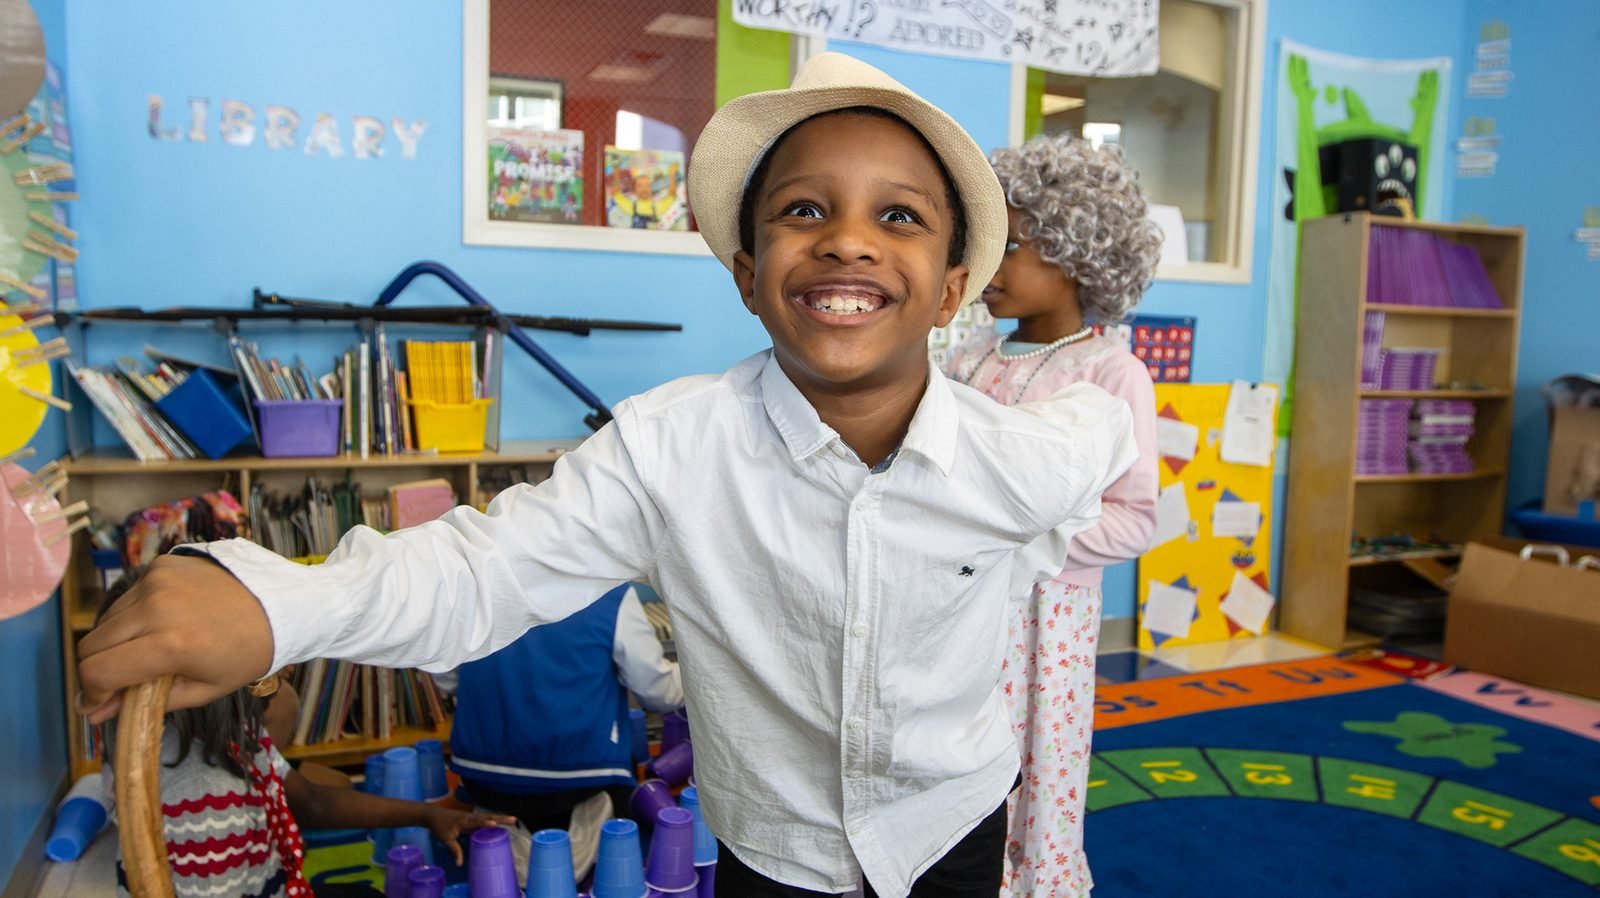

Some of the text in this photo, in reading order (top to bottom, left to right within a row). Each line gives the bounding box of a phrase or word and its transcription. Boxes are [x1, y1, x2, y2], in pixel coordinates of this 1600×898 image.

[887, 19, 985, 51] ADORED
[147, 94, 429, 160] LIBRARY
[494, 160, 576, 184] PROMISE
[1140, 760, 1198, 784] 12
[1241, 763, 1293, 786] 13
[1346, 774, 1398, 800] 14
[1451, 800, 1515, 831] 15
